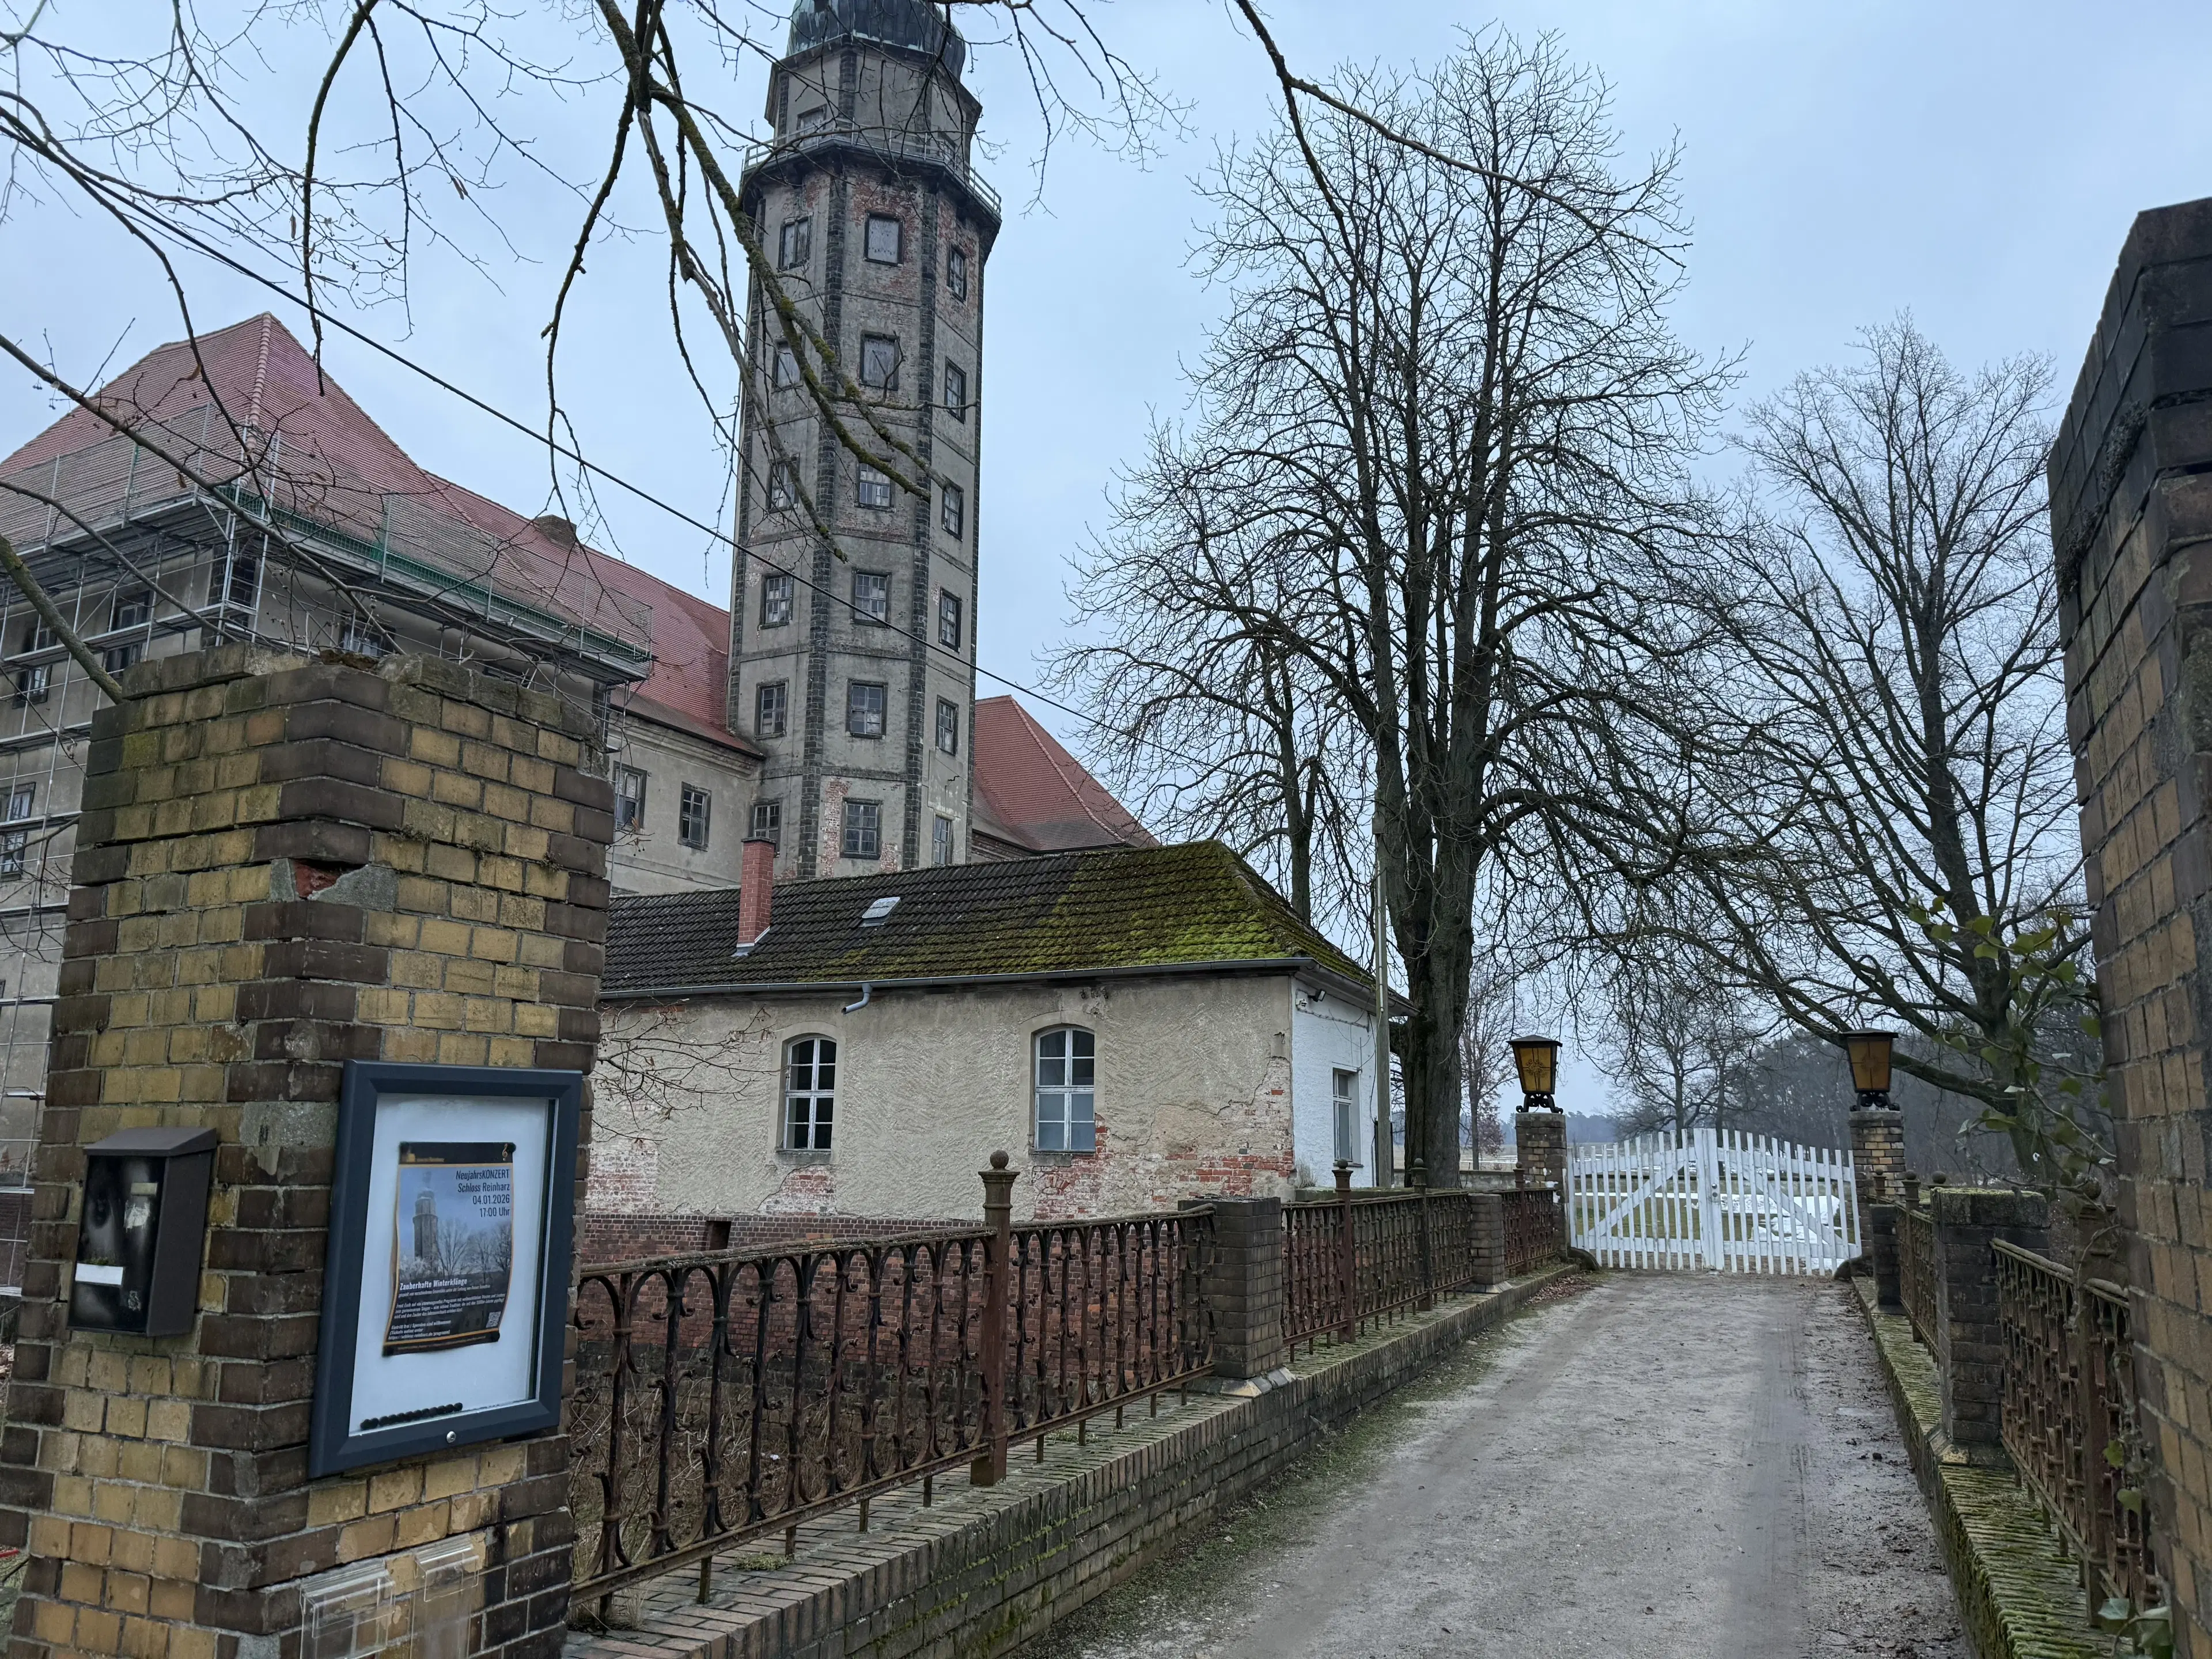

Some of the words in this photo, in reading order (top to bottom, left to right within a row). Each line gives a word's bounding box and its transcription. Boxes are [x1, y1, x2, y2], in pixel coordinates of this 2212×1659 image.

[456, 1169, 510, 1181] NeujahrsKONZERT
[458, 1183, 481, 1192] Schloss
[482, 1182, 510, 1192] Reinharz
[472, 1194, 510, 1205] 04.01.2026
[479, 1207, 497, 1217] 17:00
[499, 1207, 510, 1216] Uhr
[400, 1281, 432, 1290] Zauberhafte
[433, 1278, 467, 1287] Winterklänge
